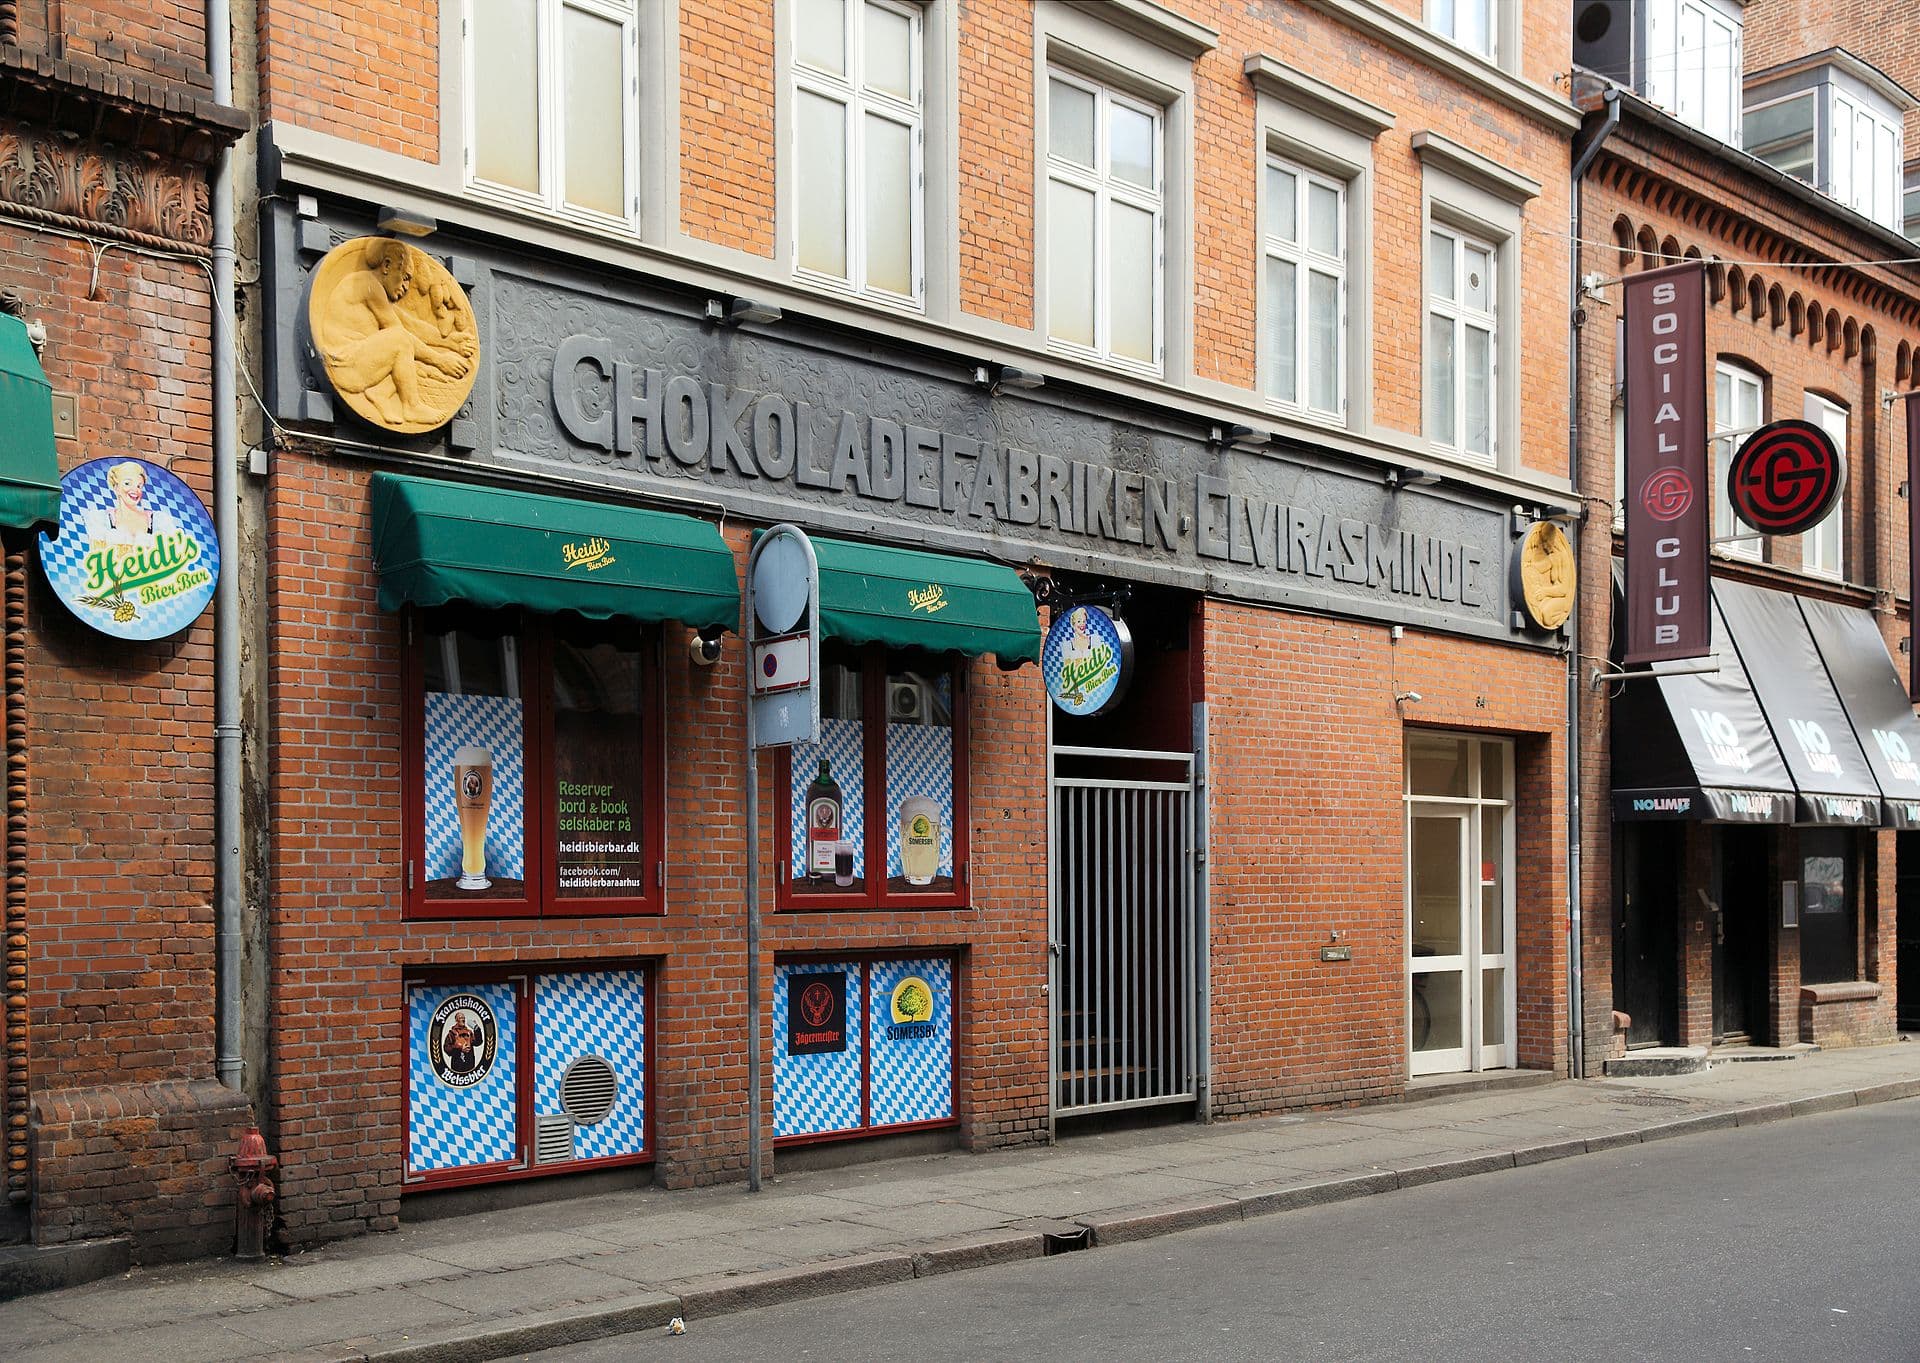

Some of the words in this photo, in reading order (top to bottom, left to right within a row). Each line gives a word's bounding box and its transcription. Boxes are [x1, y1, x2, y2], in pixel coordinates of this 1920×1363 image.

[1652, 282, 1681, 454] SOCIAL
[562, 537, 611, 563] Heidi's
[1196, 474, 1482, 606] ELVIRASMINDE
[86, 530, 199, 590] Heidi's
[141, 583, 178, 605] Bier
[176, 568, 209, 592] Bar
[908, 583, 943, 606] Heidi's
[1655, 537, 1681, 645] CLUB
[1062, 643, 1112, 689] Heidi's
[1690, 707, 1740, 747] NO
[1788, 718, 1832, 754] NO
[1871, 728, 1912, 762] NO
[559, 781, 613, 797] Reserver
[559, 799, 586, 813] bord
[589, 803, 598, 814] &
[601, 800, 629, 815] book
[559, 816, 615, 832] selskaber
[618, 816, 632, 832] på
[559, 841, 640, 853] heidisbierbar.dk
[559, 866, 621, 877] facebook.com/
[559, 877, 640, 888] heidisbierbaraarhus
[435, 996, 491, 1025] Franziskaner
[886, 1023, 939, 1042] SOMERSBY
[441, 1064, 486, 1086] Weissbier
